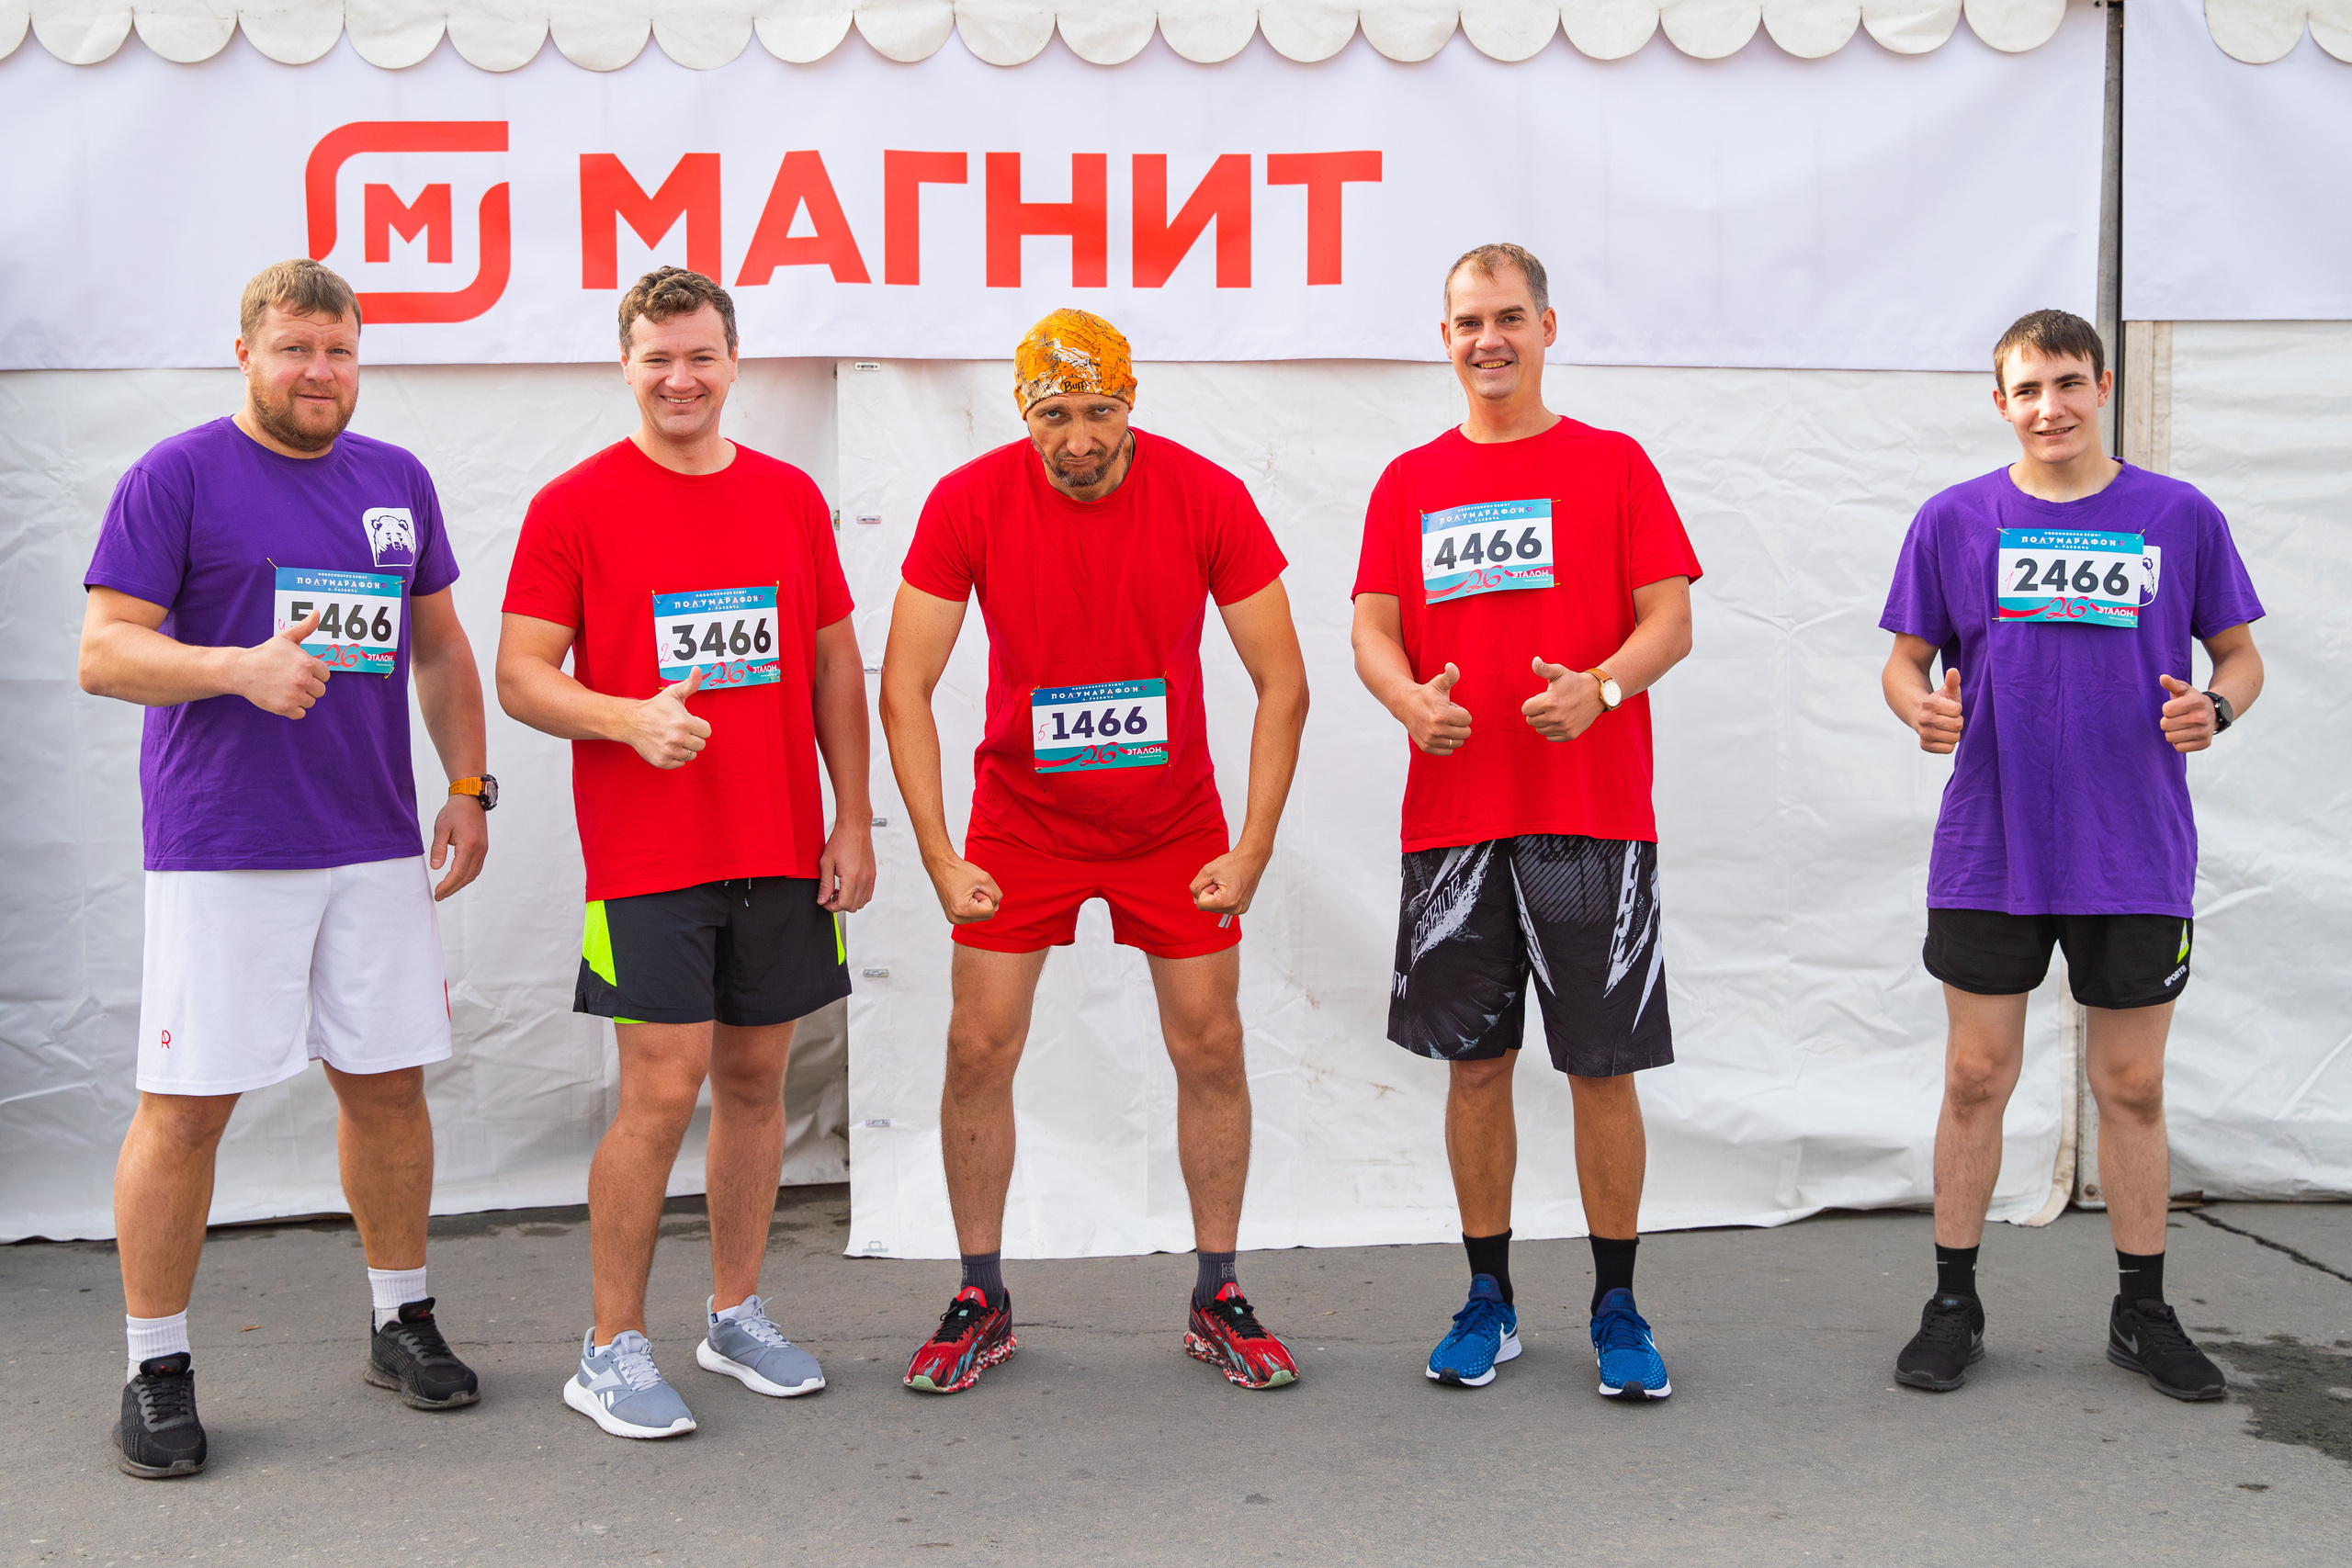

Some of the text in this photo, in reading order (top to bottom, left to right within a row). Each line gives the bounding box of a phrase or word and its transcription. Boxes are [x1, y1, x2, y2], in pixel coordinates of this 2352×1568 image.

[580, 150, 1383, 289] МАГНИТ
[1063, 381, 1086, 392] Buff
[1439, 507, 1524, 525] ПОЛУМАРАФОН
[1433, 526, 1543, 570] 4466
[2021, 536, 2116, 547] ПОЛУМАРАФОН
[1424, 558, 1433, 576] 3
[1511, 570, 1549, 579] ЭТАЛОН
[2013, 558, 2130, 596] 2466
[297, 577, 379, 589] ПОЛУМАРАФОН
[1465, 564, 1503, 593] 26
[2005, 570, 2015, 592] 1
[674, 594, 758, 609] ПОЛУМАРАФОН
[2045, 595, 2089, 619] 26
[2098, 606, 2134, 617] ЭТАЛОН
[290, 601, 392, 642] 5466
[672, 617, 771, 660] 3466
[323, 643, 360, 668] 26
[367, 653, 393, 662] ЭТАЛОН
[660, 642, 673, 663] 2
[708, 659, 746, 687] 26
[752, 664, 777, 674] ЭТАЛОН
[1051, 686, 1138, 700] ПОЛУМАРАФОН
[1037, 722, 1051, 741] 5
[1051, 705, 1148, 740] 1466
[1079, 741, 1119, 767] 26
[1126, 746, 1162, 756] ЭТАЛОН
[2164, 964, 2188, 987] SPORTS
